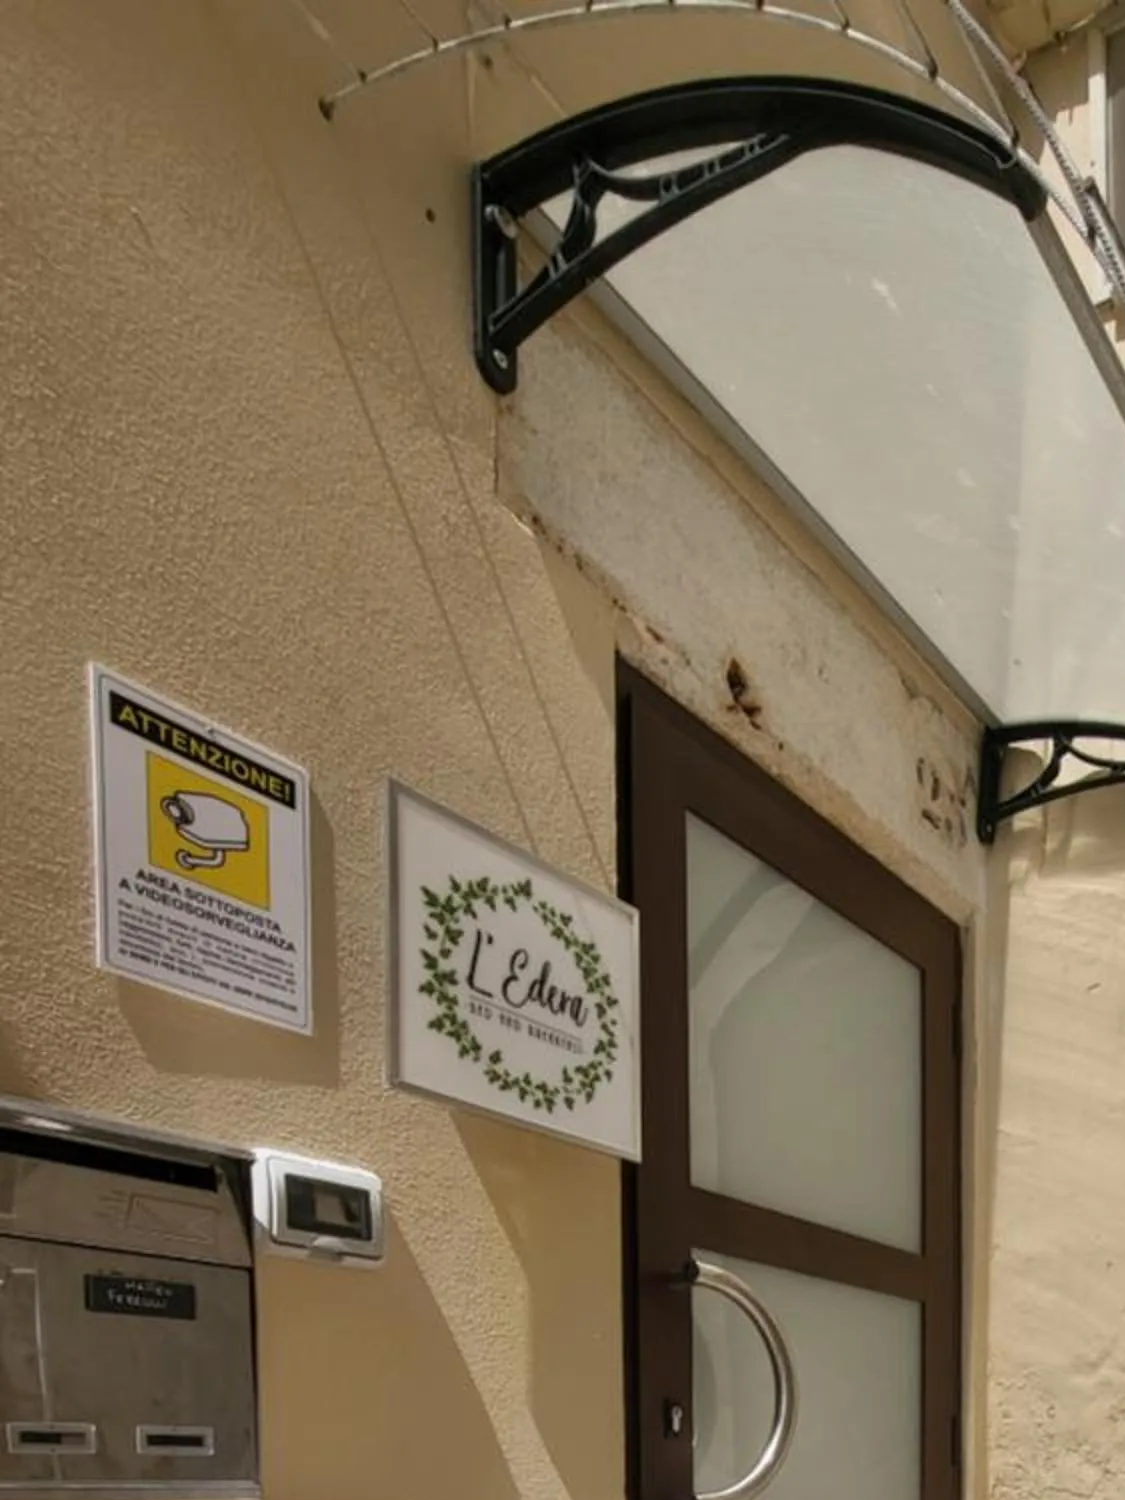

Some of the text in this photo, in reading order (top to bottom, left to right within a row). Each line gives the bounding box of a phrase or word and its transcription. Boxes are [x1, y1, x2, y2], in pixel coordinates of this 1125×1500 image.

[118, 704, 293, 801] ATTENZIONE!
[118, 877, 296, 952] A VIDEOSORVEGLIANZA
[135, 868, 282, 932] AREA SOTTOPOSTA
